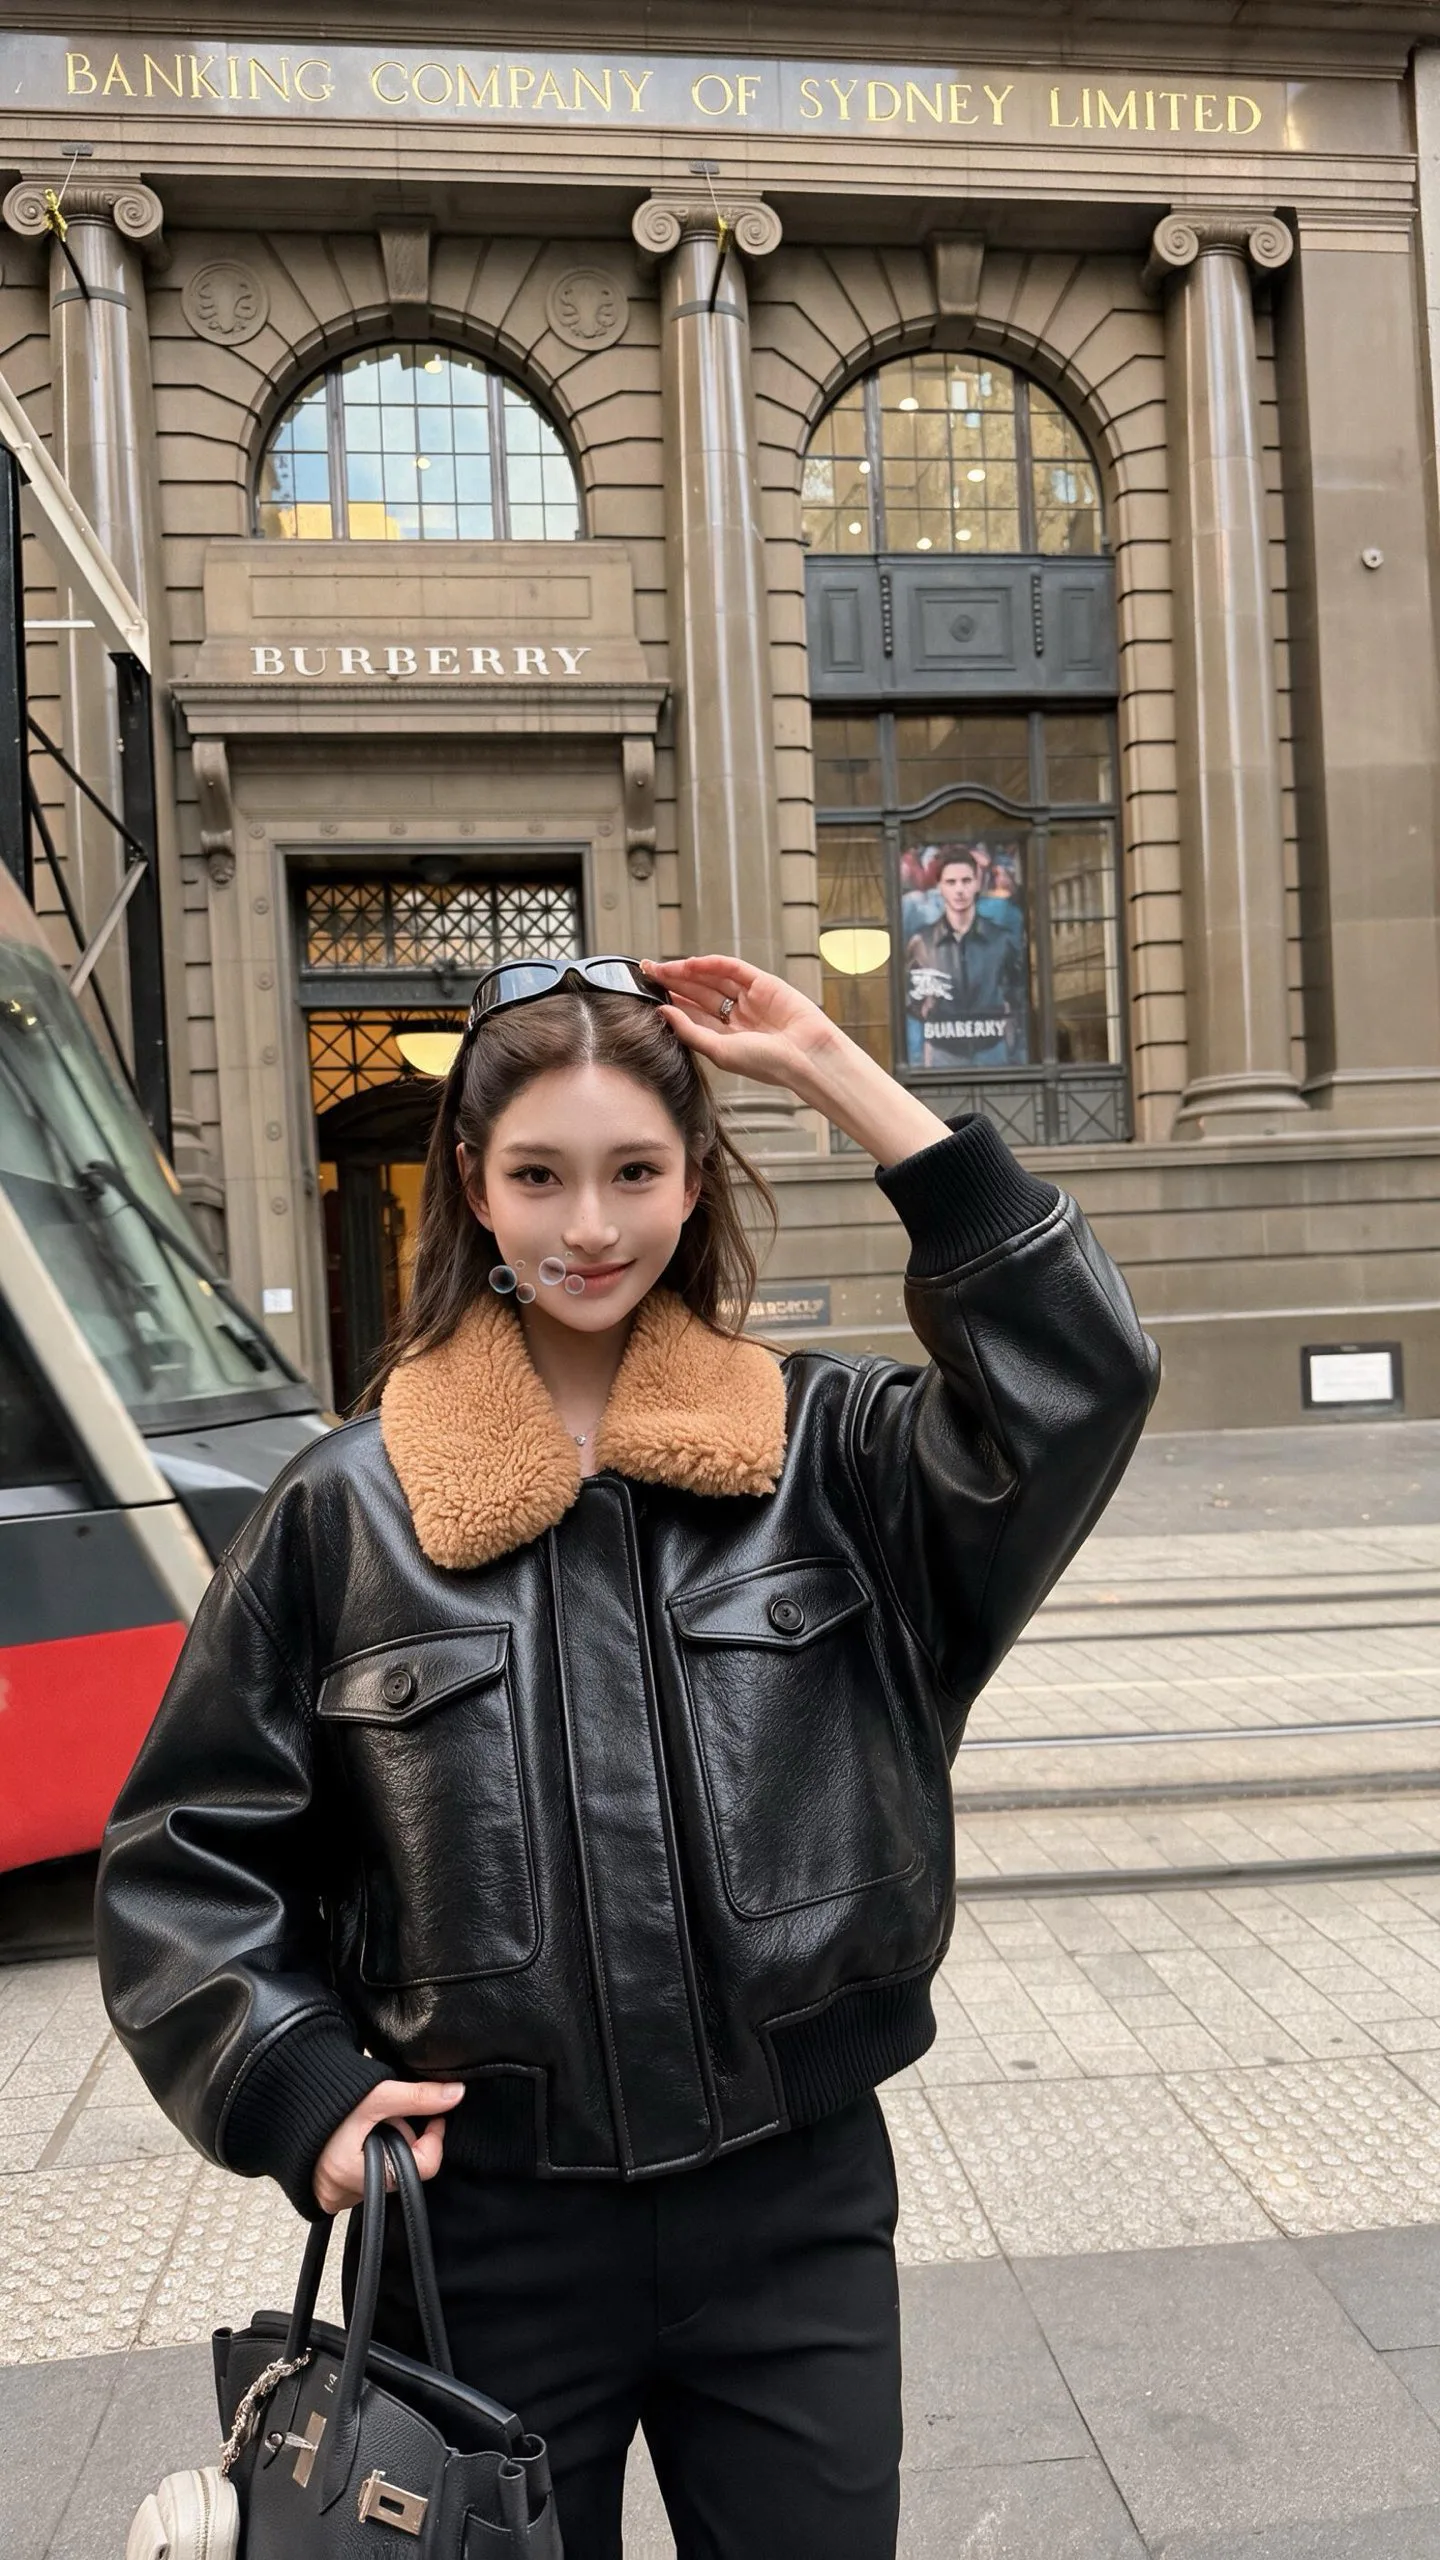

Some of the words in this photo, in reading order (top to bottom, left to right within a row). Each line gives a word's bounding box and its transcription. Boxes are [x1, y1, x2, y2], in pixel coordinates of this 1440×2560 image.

[66, 53, 336, 104] BANKING
[371, 61, 653, 113] COMPANY
[691, 75, 761, 116] OF
[800, 79, 1014, 126] SYDNEY
[1049, 87, 1263, 135] LIMITED
[250, 646, 591, 676] BURBERRY
